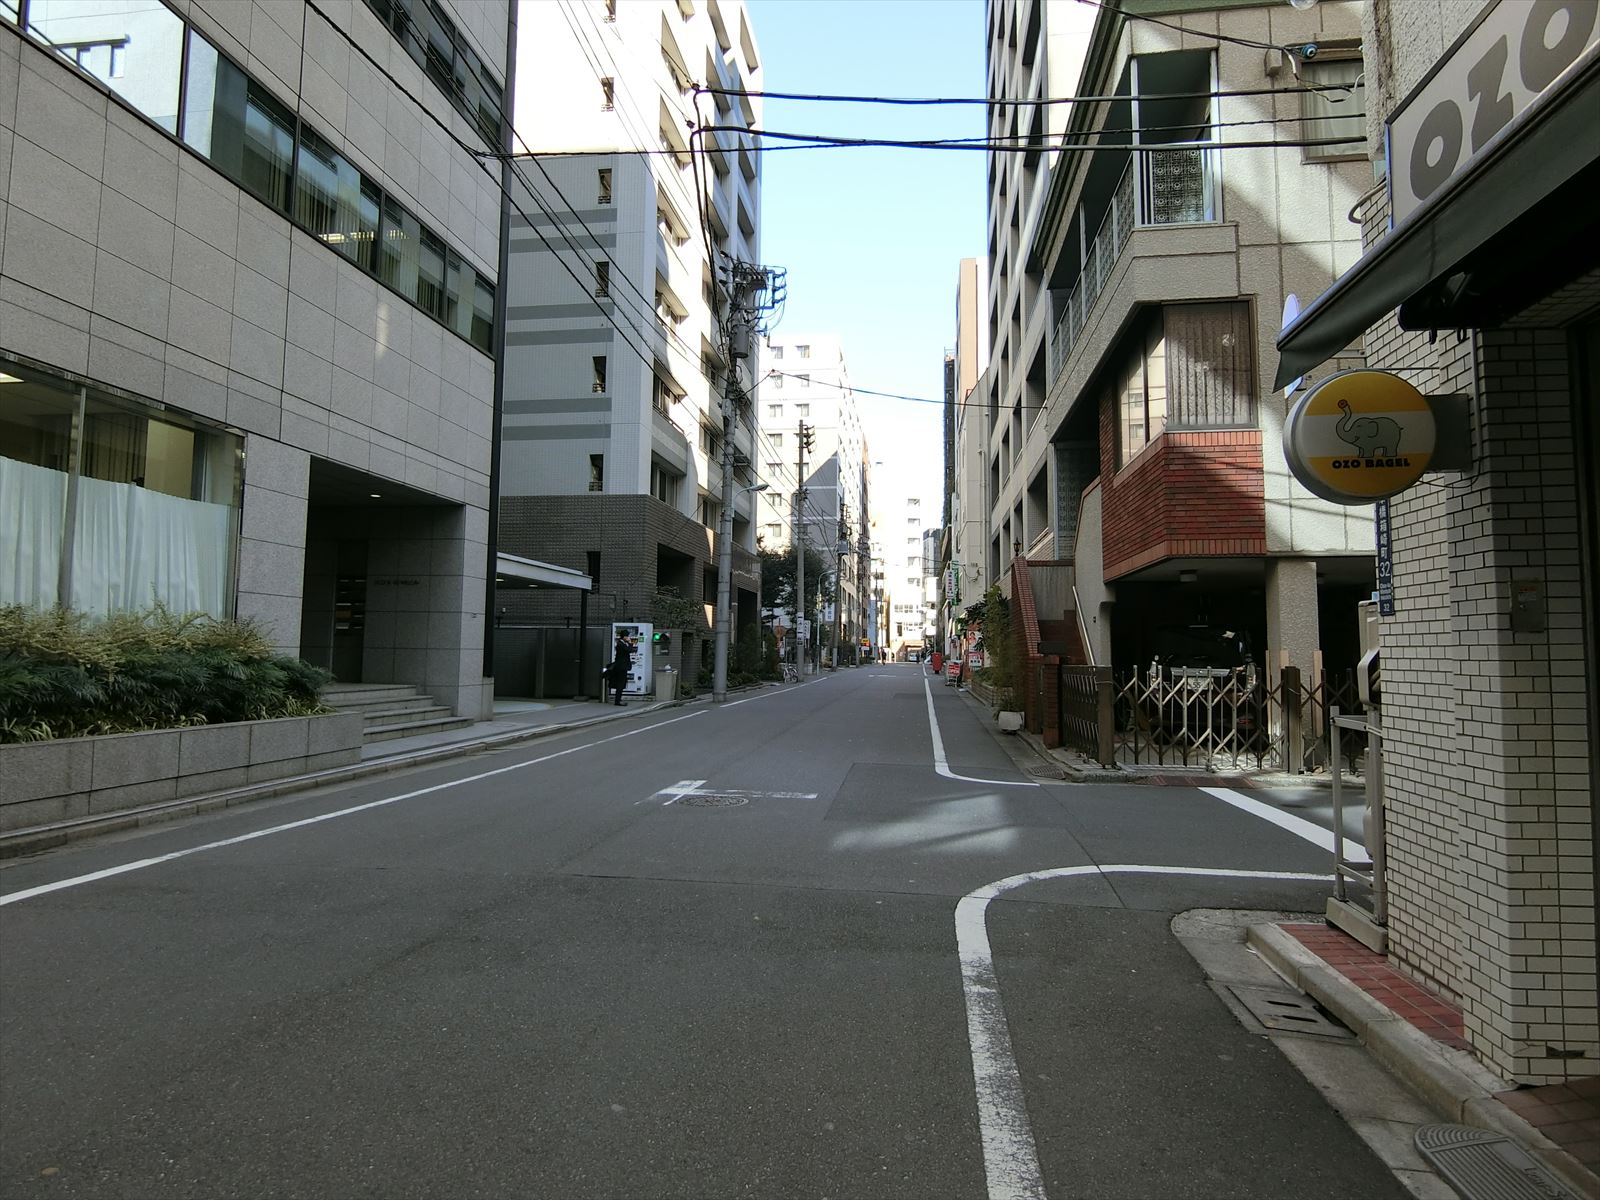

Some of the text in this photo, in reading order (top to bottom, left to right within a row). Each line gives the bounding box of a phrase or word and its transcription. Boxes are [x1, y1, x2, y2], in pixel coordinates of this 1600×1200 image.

[1409, 0, 1598, 201] OZO
[1332, 458, 1411, 469] OZO BAGEL
[1379, 561, 1391, 577] 32
